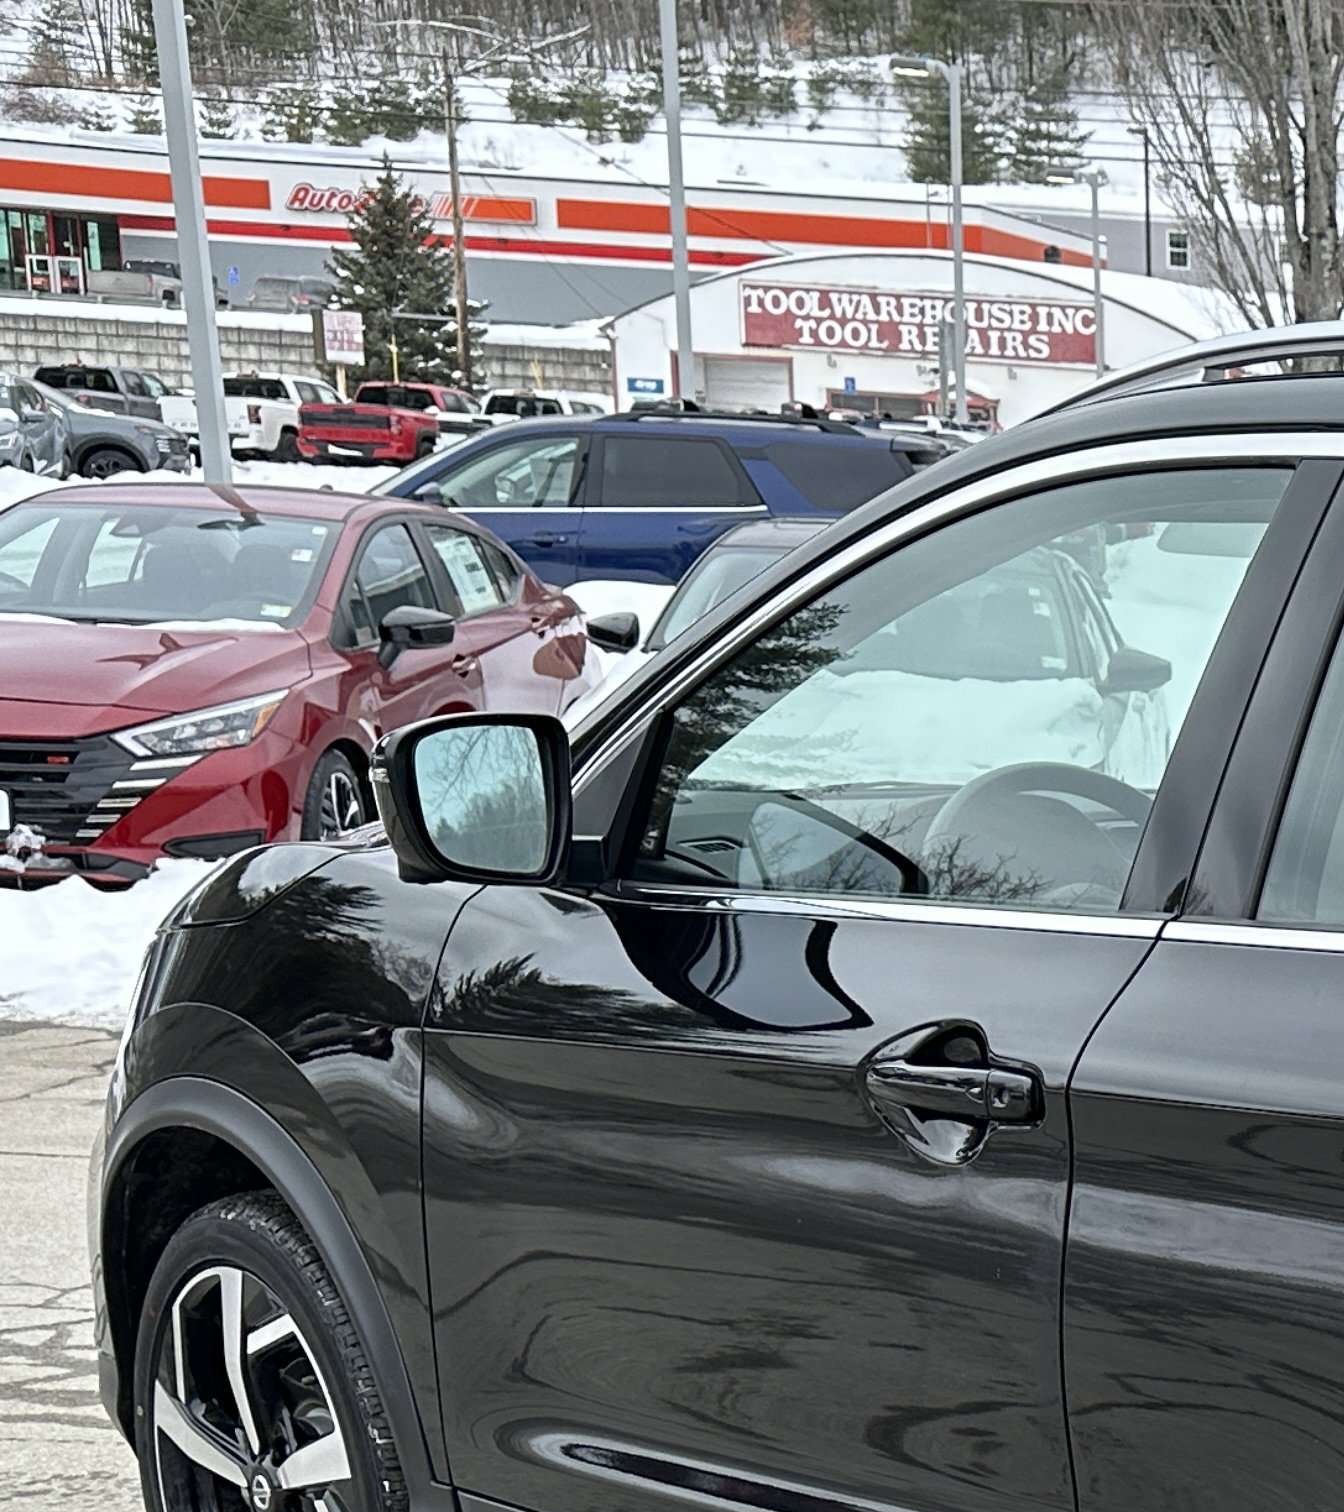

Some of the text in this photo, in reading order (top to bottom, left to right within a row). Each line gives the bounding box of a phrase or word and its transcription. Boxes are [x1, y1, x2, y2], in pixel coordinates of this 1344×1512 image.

[794, 317, 1051, 360] TOOL REAIRS
[1036, 305, 1097, 336] INC
